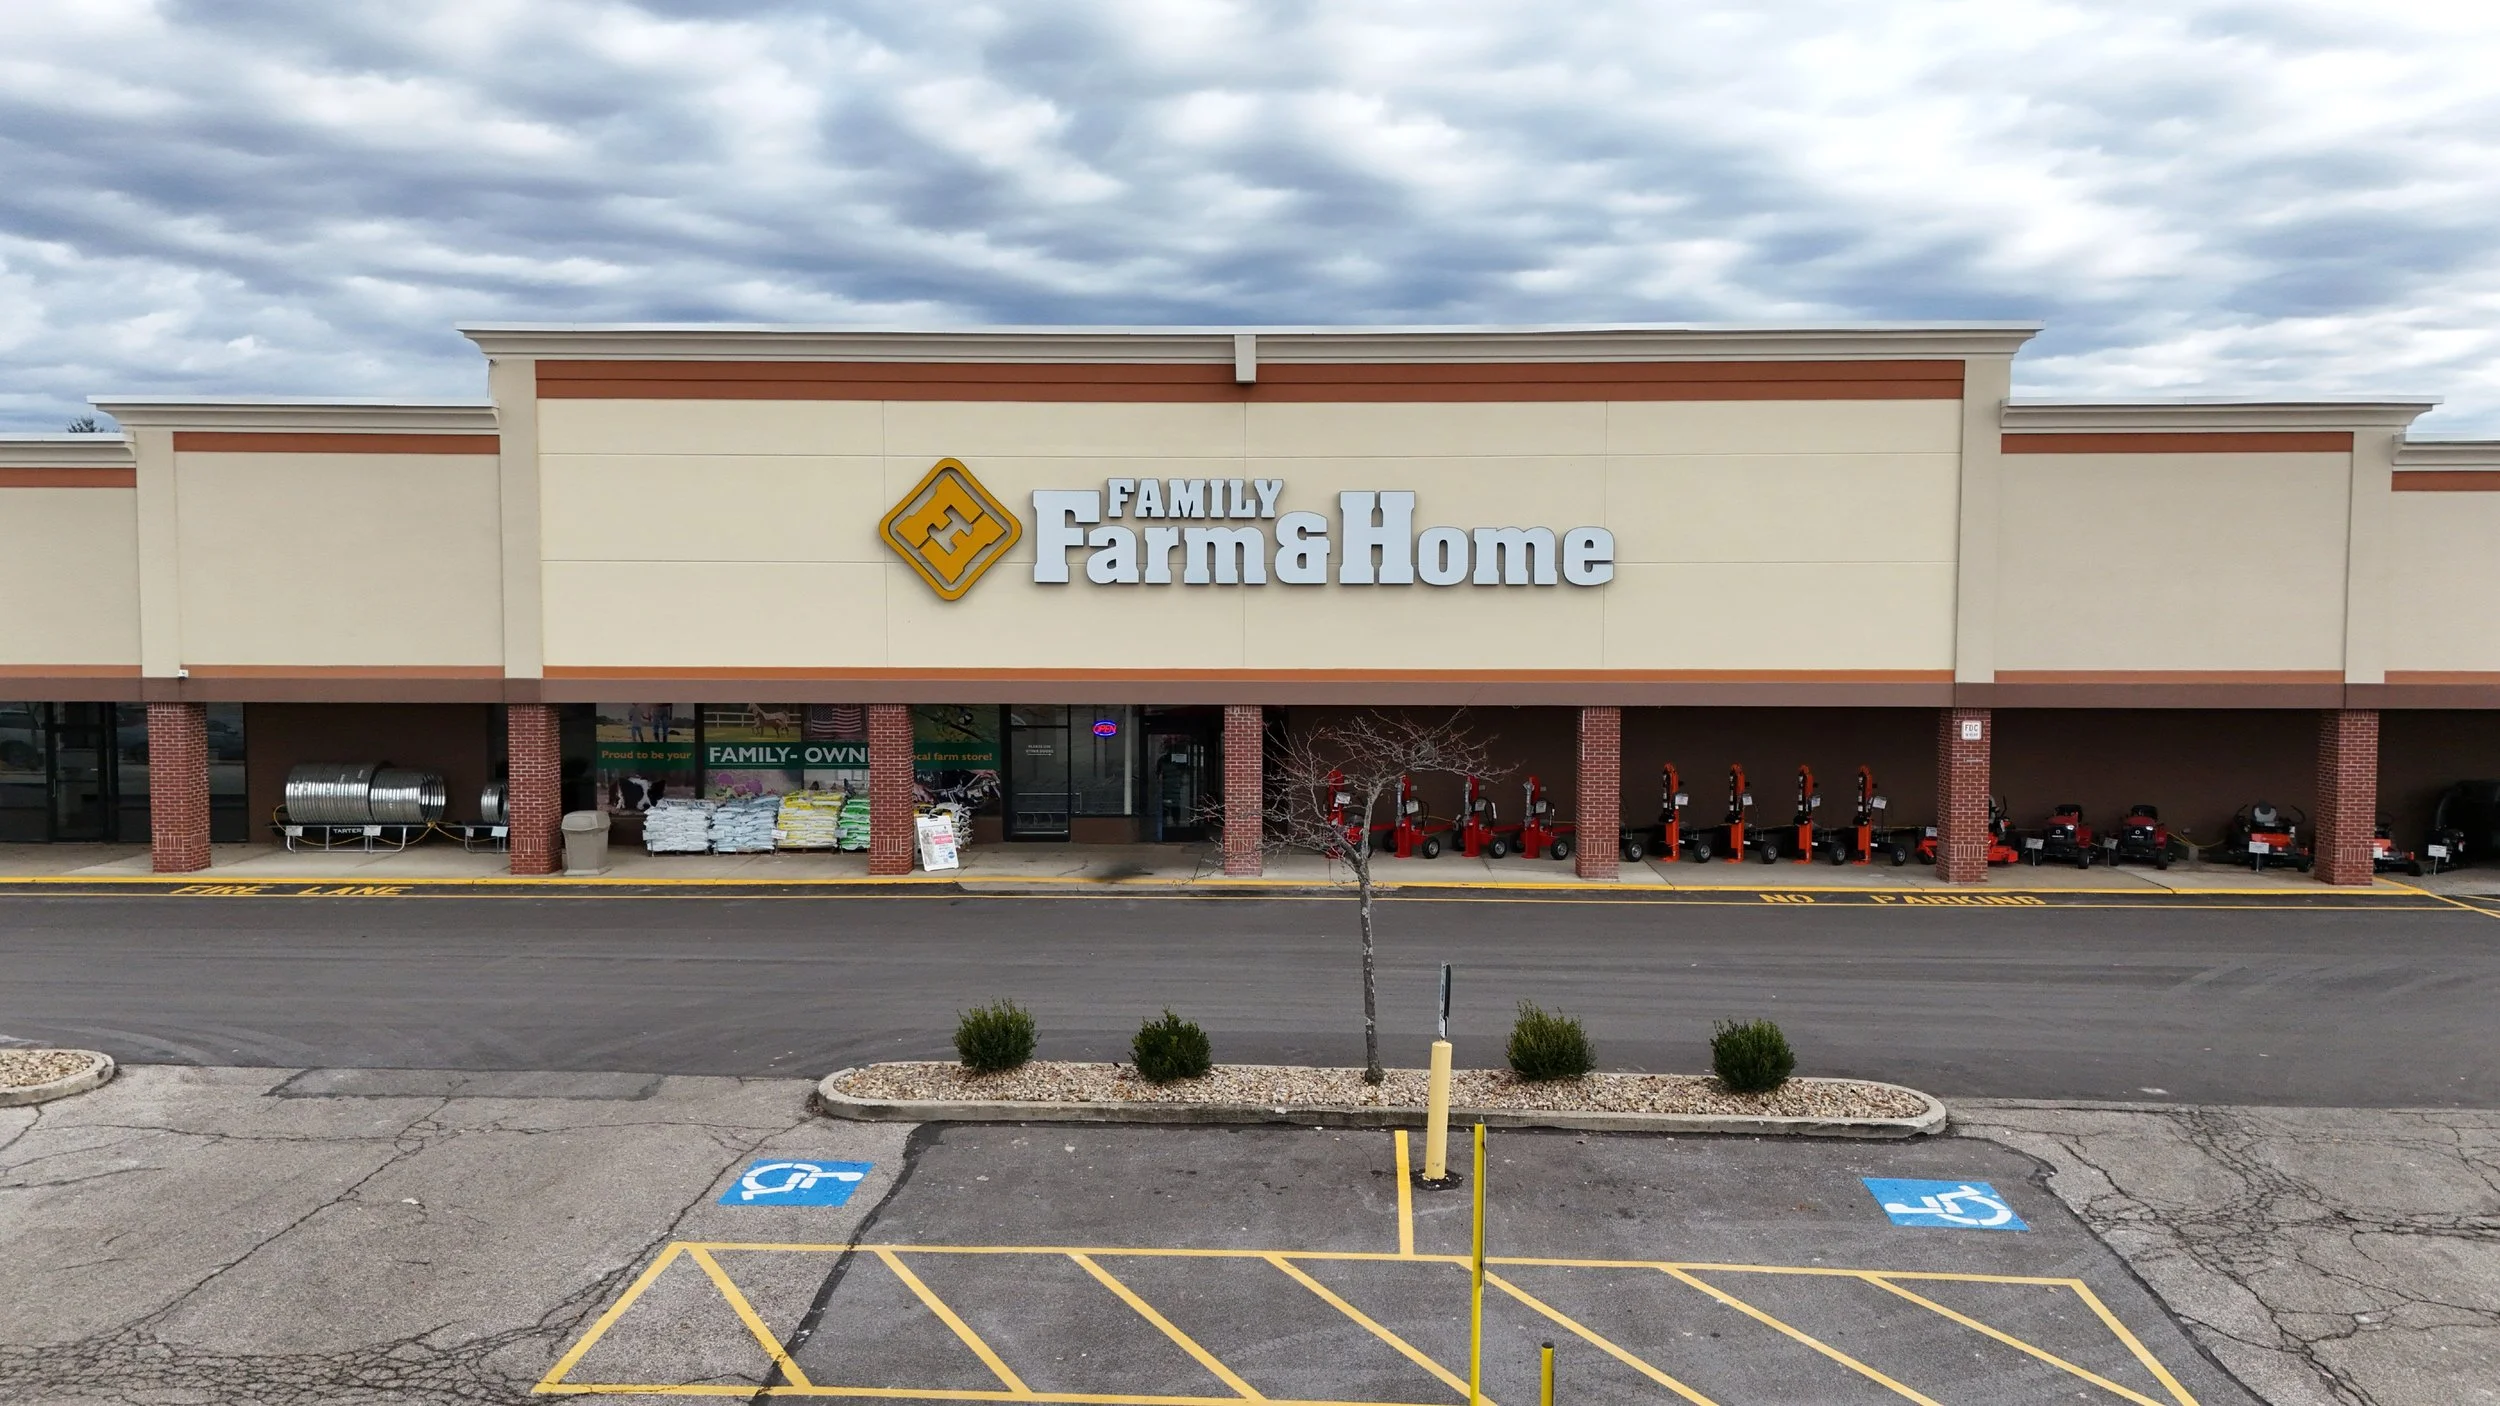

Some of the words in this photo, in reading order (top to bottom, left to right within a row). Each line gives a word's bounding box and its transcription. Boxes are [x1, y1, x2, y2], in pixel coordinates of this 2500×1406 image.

[1107, 478, 1283, 519] FAMILY
[1093, 724, 1117, 734] OPEN
[601, 751, 633, 760] Proud
[637, 752, 648, 760] to
[651, 751, 665, 760] be
[667, 752, 692, 762] your
[804, 747, 870, 763] OWN
[170, 885, 275, 895] FIRE
[297, 886, 414, 896] LANE
[1759, 894, 1815, 903] NO
[1870, 895, 2046, 905] PARKING
